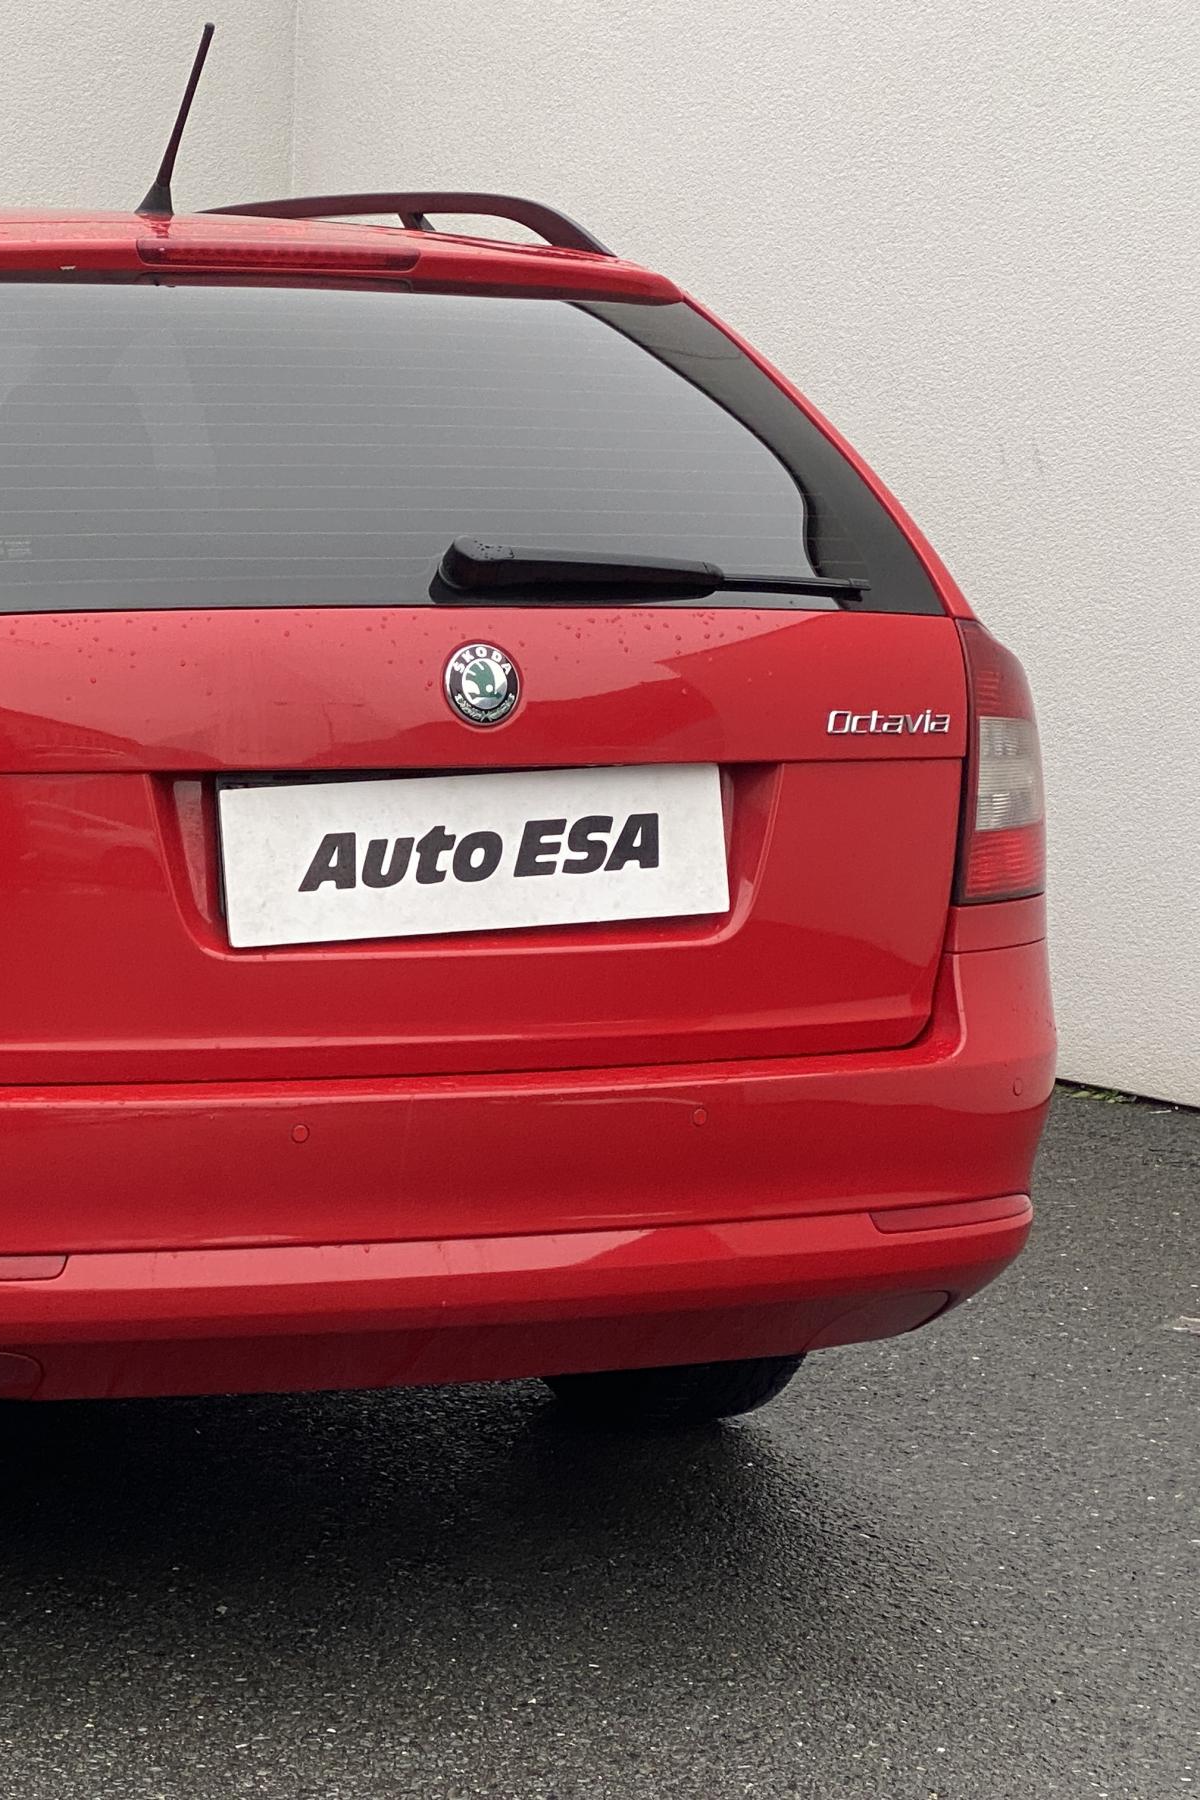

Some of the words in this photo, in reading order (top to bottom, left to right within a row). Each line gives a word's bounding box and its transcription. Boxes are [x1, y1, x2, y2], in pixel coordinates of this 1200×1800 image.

[826, 709, 951, 734] Octavia
[298, 825, 503, 892] Auto
[513, 812, 660, 878] ESA
